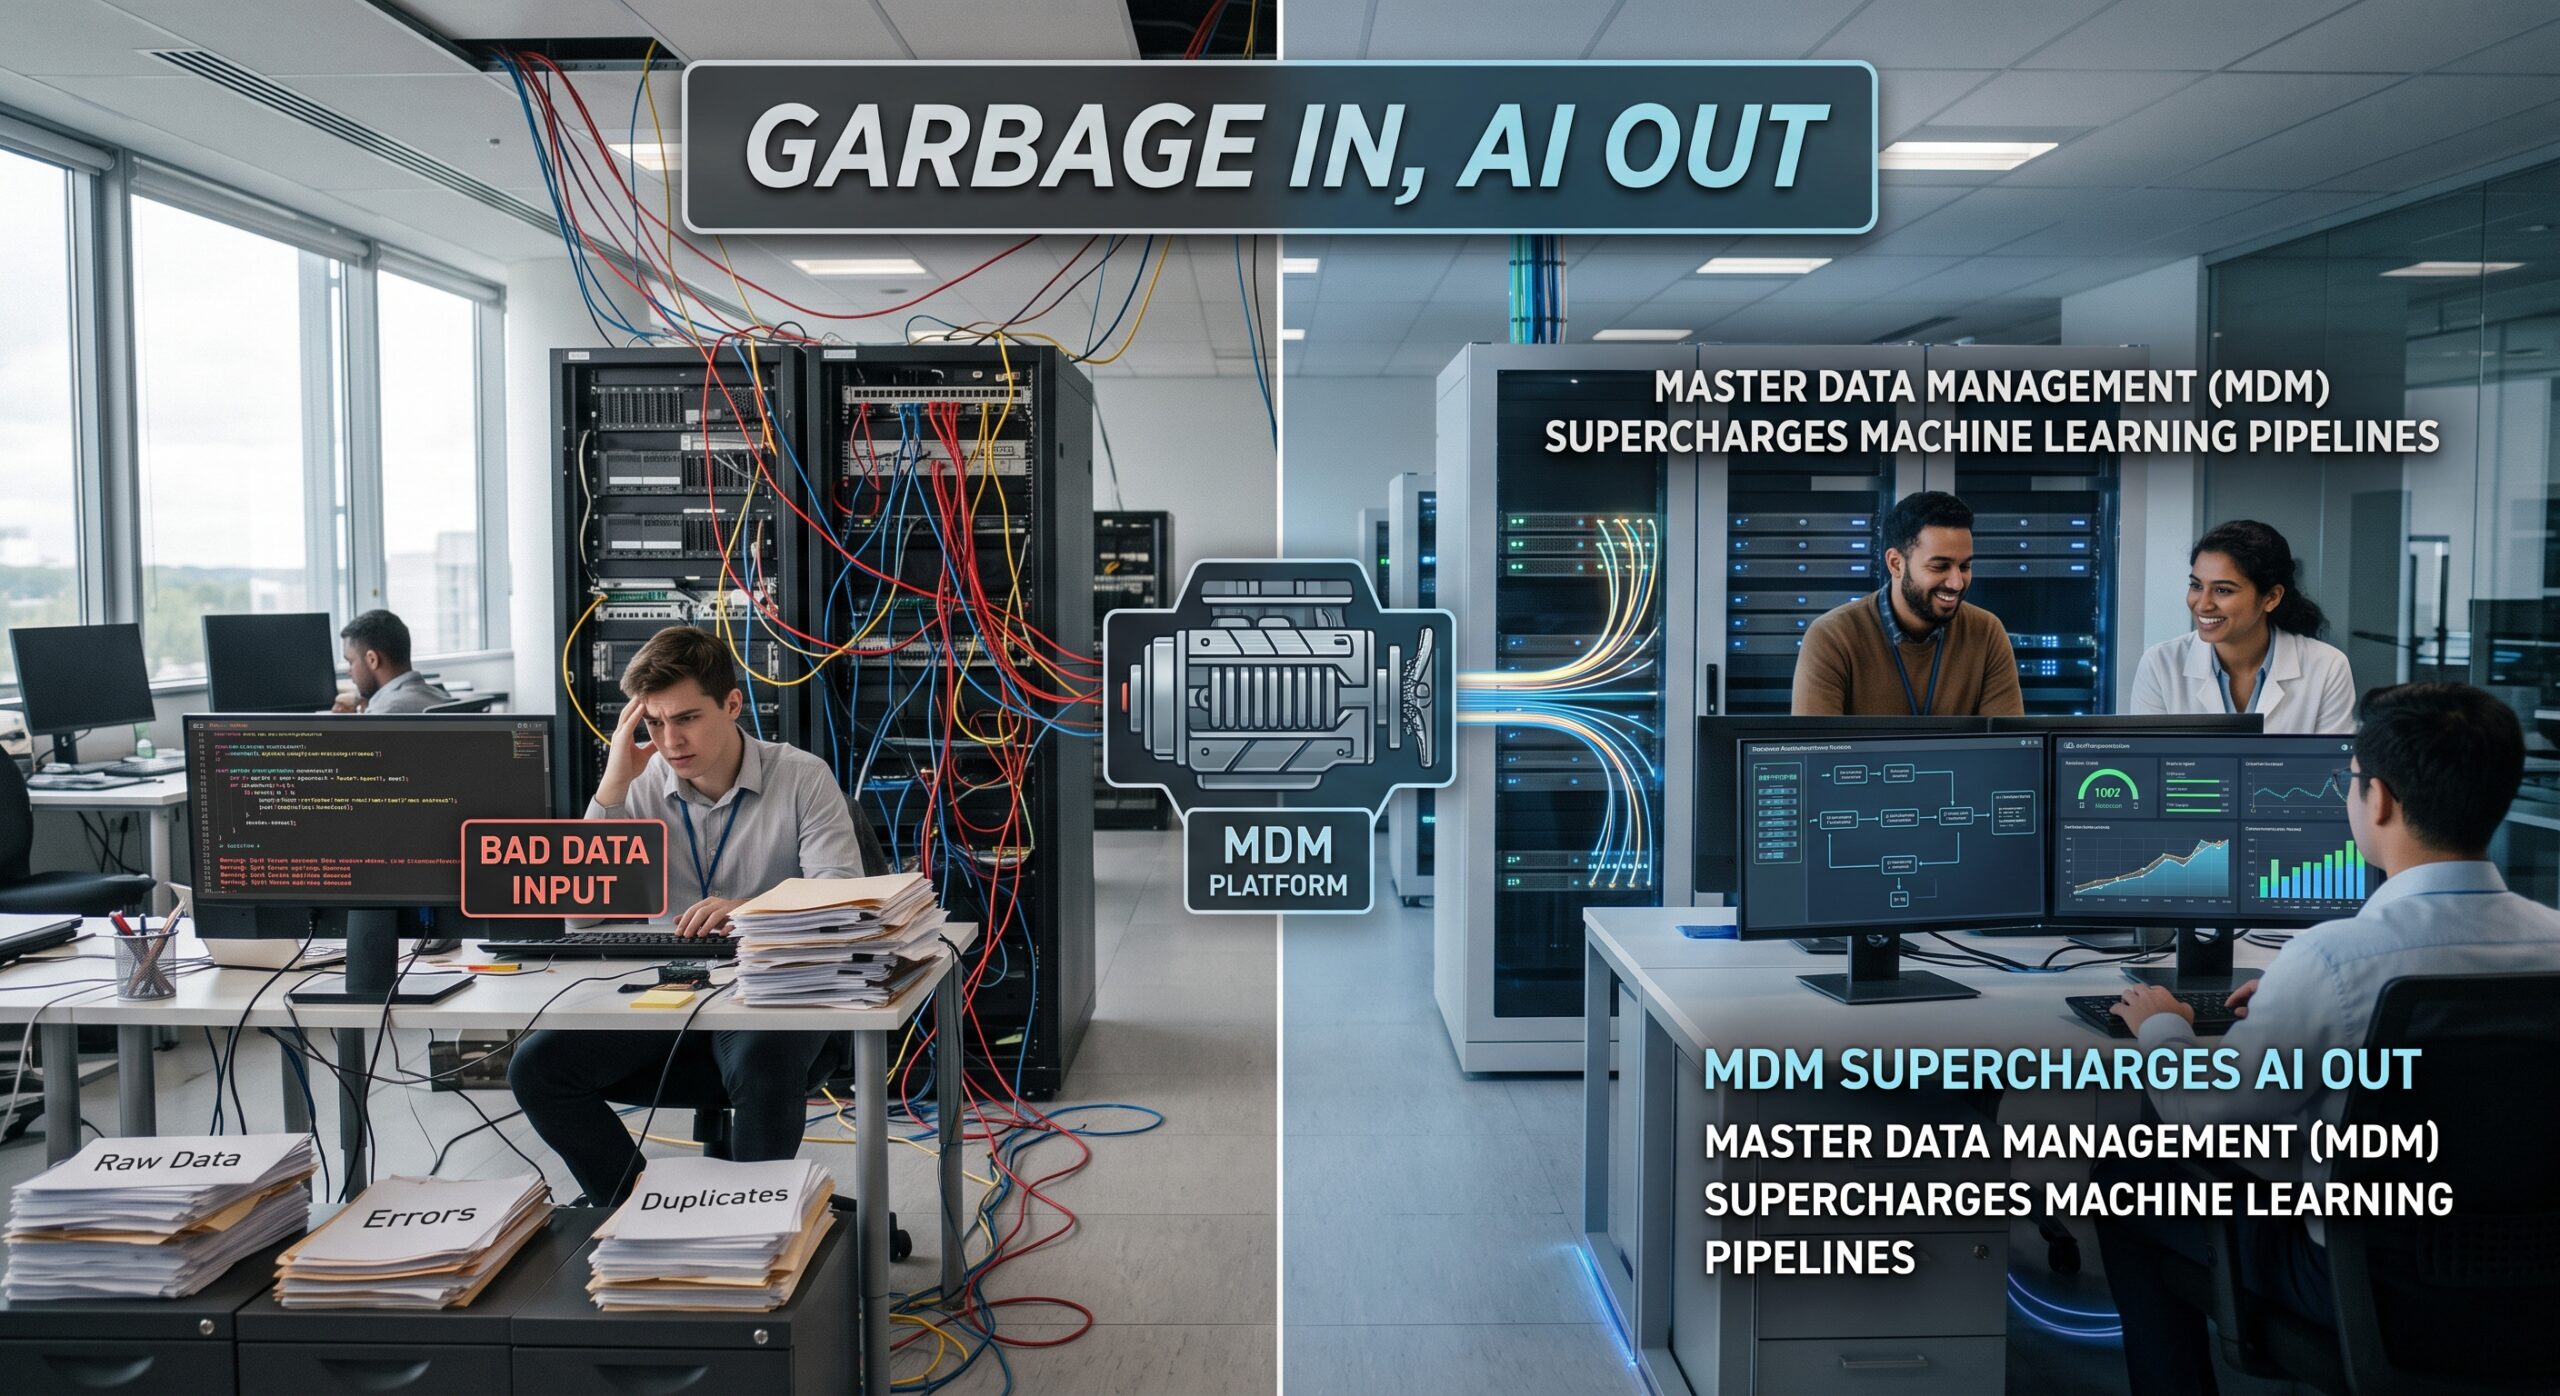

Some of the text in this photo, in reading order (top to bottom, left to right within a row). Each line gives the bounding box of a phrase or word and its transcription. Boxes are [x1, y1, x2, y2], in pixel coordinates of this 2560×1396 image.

[94, 1151, 241, 1172] Raw Data
[640, 1188, 788, 1213] Duplicates
[363, 1207, 477, 1229] Errors
